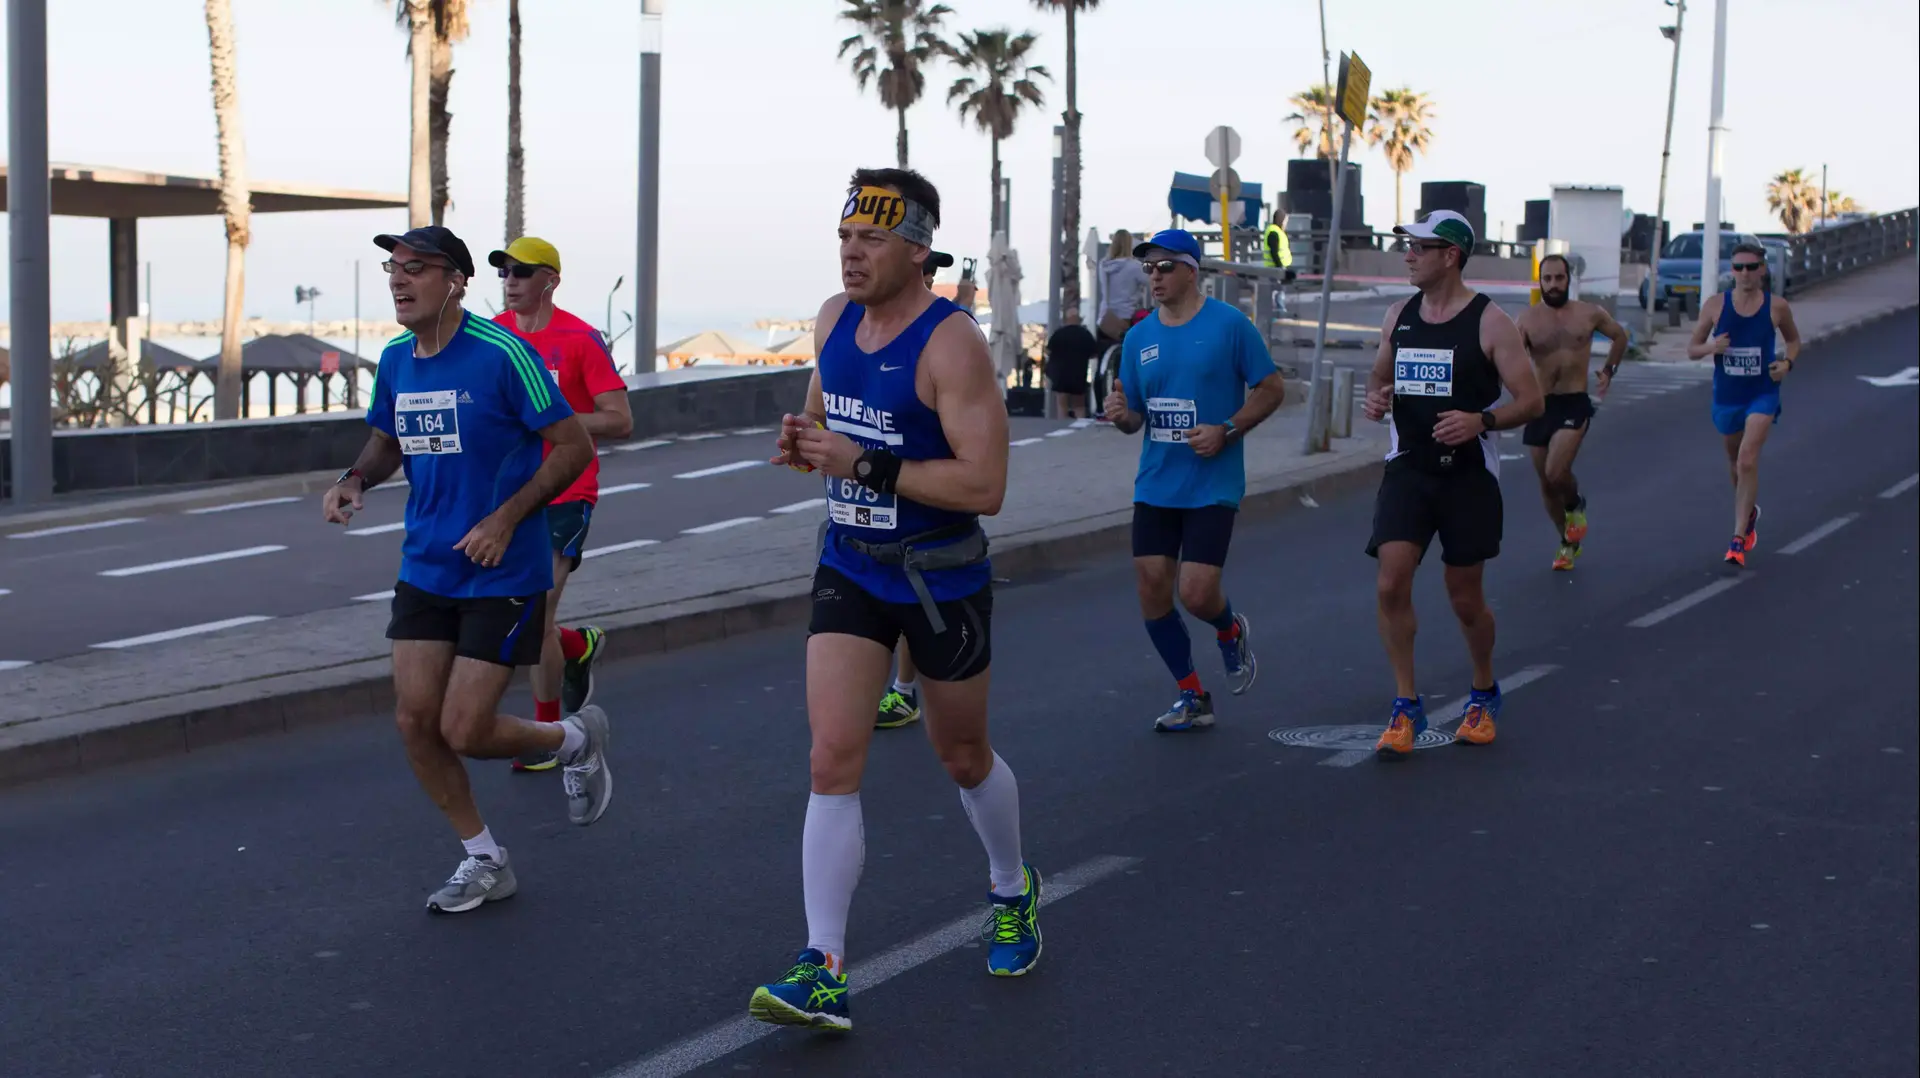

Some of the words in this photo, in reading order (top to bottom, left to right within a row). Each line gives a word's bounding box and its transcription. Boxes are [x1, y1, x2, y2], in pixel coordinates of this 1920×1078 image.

[1734, 357, 1757, 367] 2105
[1398, 365, 1407, 378] B
[1412, 364, 1446, 380] 1033
[398, 415, 408, 433] B
[416, 413, 445, 433] 164
[1150, 413, 1157, 426] A
[1159, 413, 1190, 428] 1199
[841, 478, 879, 503] 675
